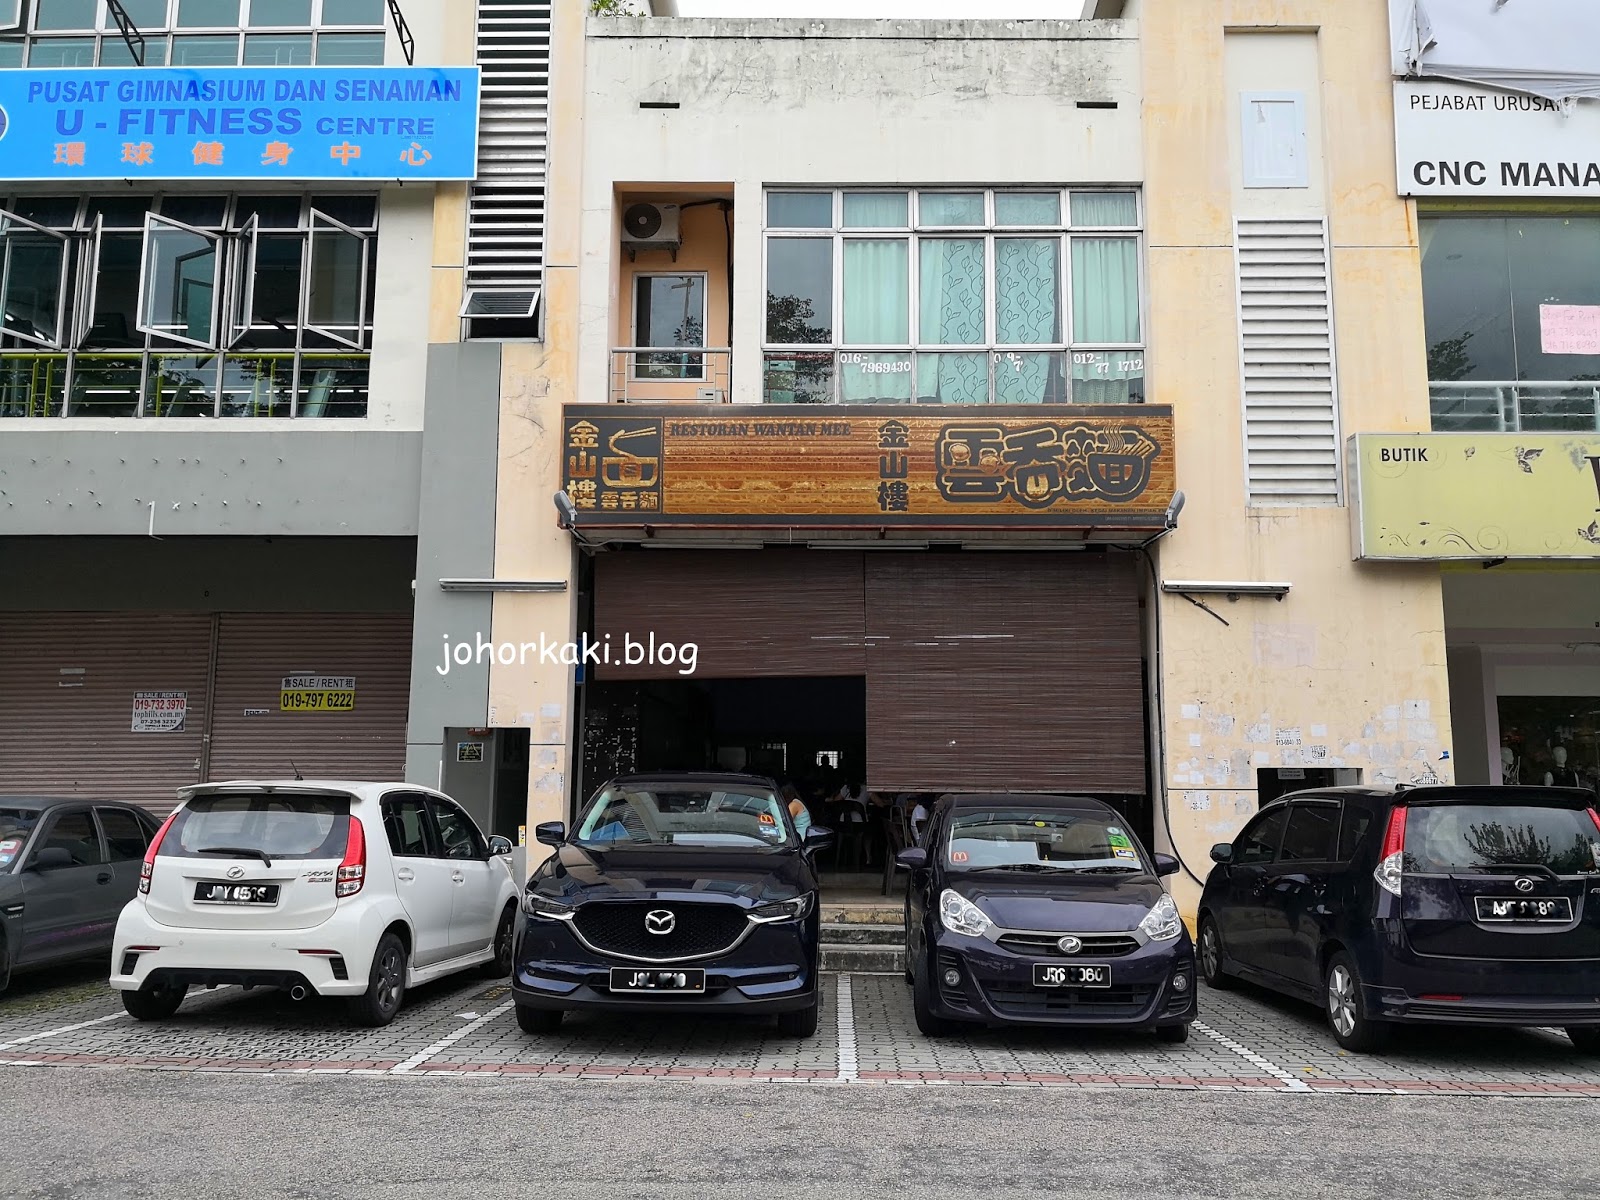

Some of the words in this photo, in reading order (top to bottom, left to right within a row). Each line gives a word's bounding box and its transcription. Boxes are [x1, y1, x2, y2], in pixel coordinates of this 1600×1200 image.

[28, 80, 110, 103] PUSAT
[117, 79, 265, 102] GIMNASIUM
[274, 79, 326, 101] DAN
[334, 79, 461, 101] SENAMAN
[1410, 94, 1486, 111] PEJABAT
[55, 109, 84, 136] U
[117, 107, 302, 135] FITNESS
[316, 117, 434, 135] CENTRE
[53, 140, 433, 166] 環球健身中心
[1413, 160, 1487, 186] CNC
[1500, 162, 1600, 187] MANA
[671, 423, 750, 437] RESTORAN
[753, 423, 816, 437] WANTAN
[820, 423, 851, 437] MEE
[1380, 447, 1429, 462] BUTIK
[877, 419, 910, 512] 金山樓
[135, 699, 165, 710] 019-732
[166, 699, 185, 710] 3970
[283, 693, 324, 708] 019-797
[327, 693, 352, 708] 6222
